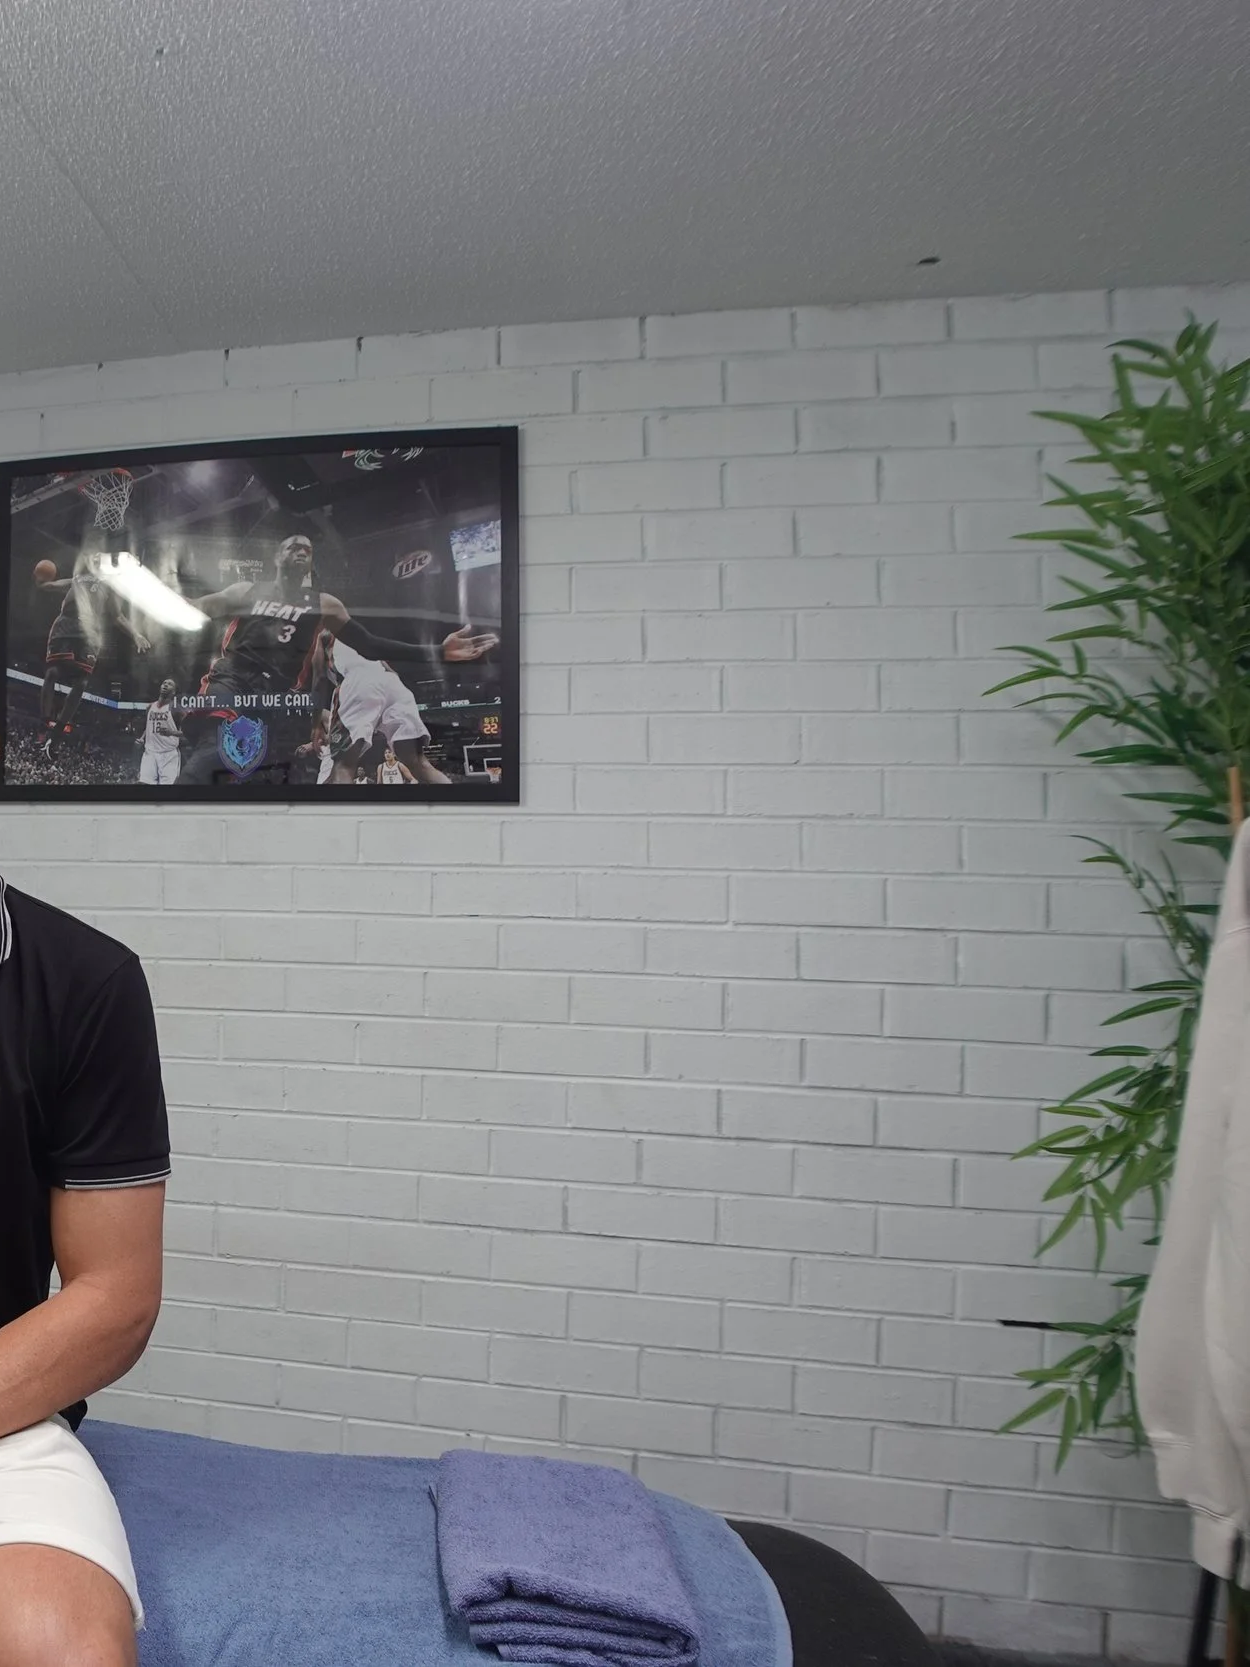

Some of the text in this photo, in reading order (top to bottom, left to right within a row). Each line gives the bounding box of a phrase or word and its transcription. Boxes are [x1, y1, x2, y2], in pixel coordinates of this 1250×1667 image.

[251, 600, 312, 622] HEAT
[277, 624, 296, 643] 3
[173, 693, 314, 708] I CAN'T... BUT WE CAN.
